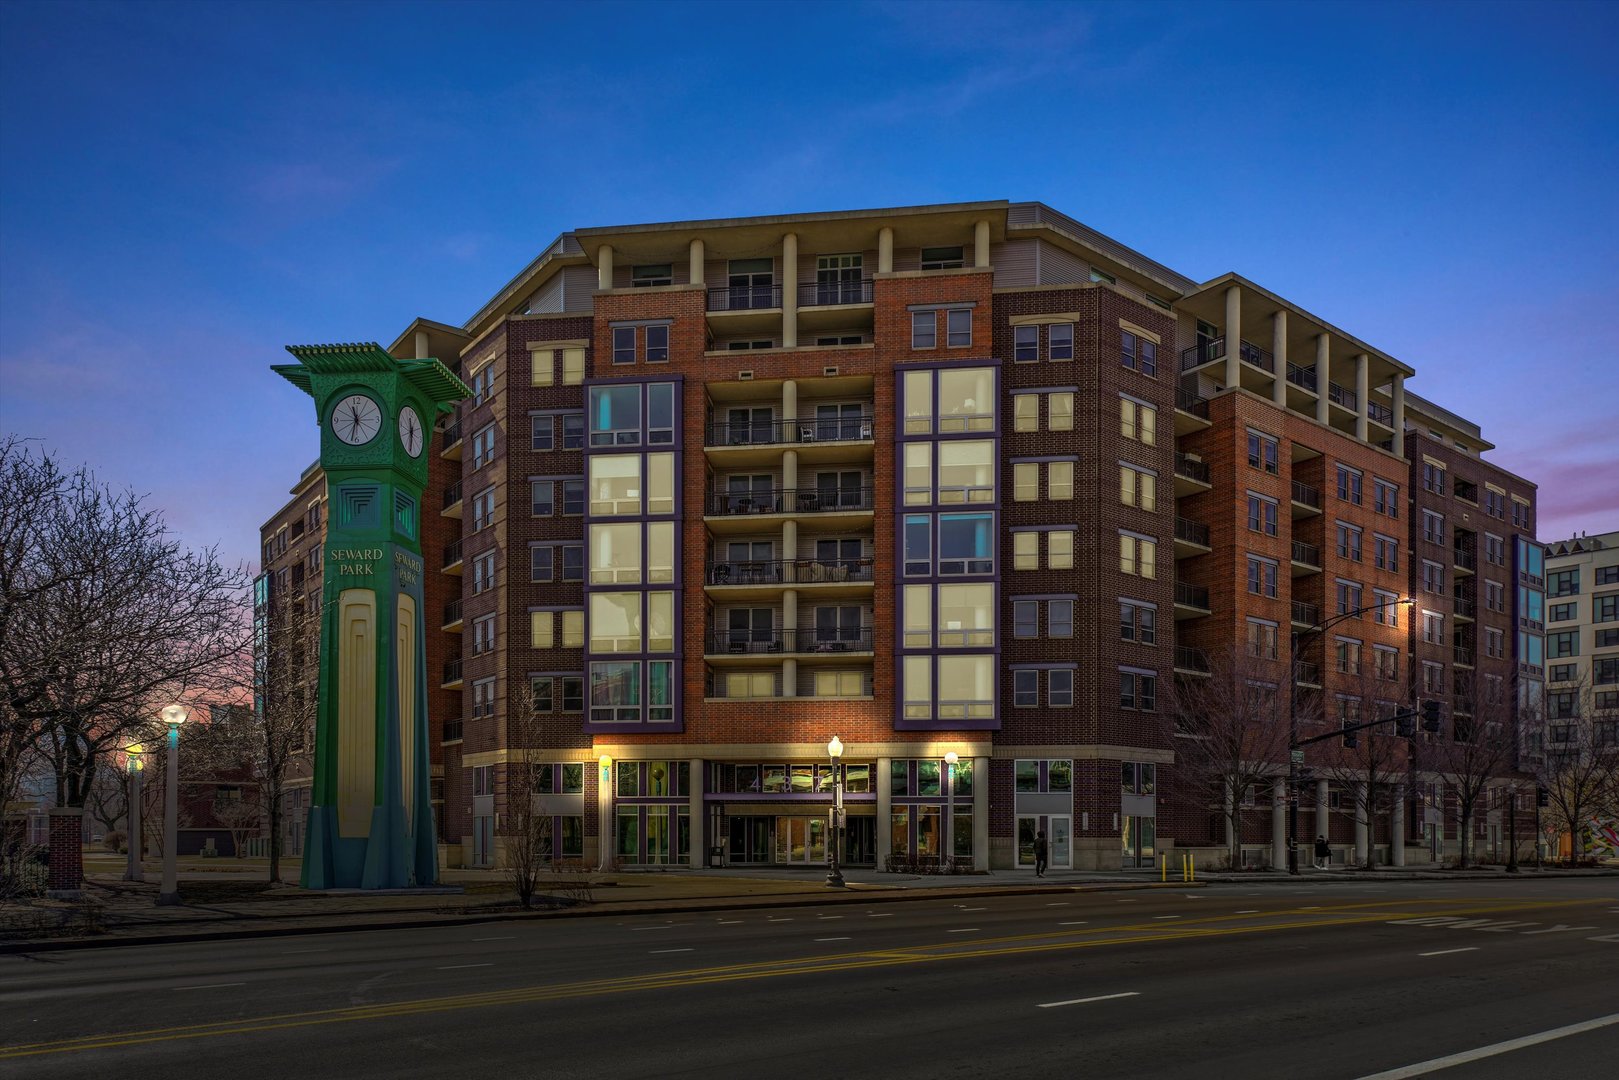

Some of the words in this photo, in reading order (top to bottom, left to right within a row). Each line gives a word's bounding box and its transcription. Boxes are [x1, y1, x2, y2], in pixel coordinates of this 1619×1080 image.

[352, 397, 361, 405] 12
[331, 549, 382, 560] SEWARD
[395, 551, 421, 573] SEWARD
[340, 564, 373, 575] PARK
[399, 568, 416, 585] PARK
[1385, 916, 1600, 934] ONLY
